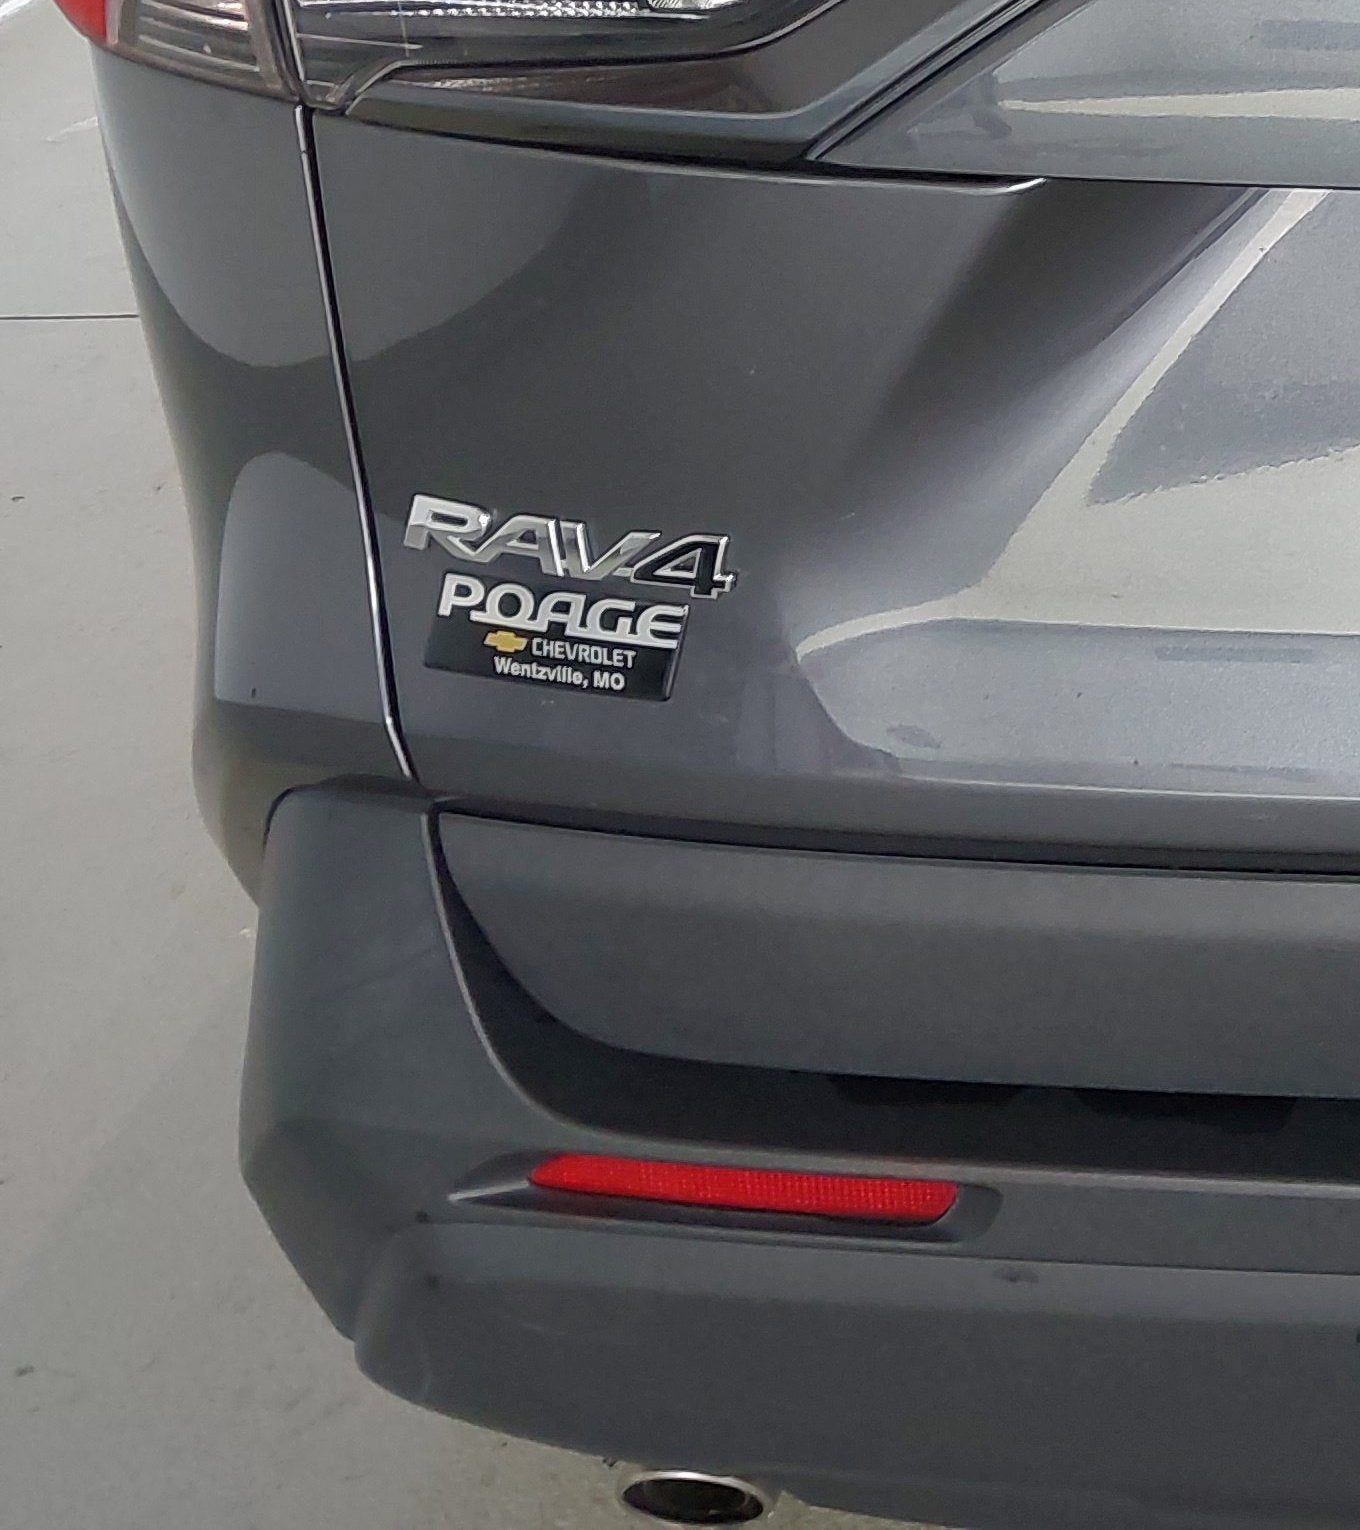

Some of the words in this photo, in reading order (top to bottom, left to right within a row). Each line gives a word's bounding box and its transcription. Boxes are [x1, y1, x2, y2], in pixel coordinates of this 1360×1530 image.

[403, 493, 738, 599] RAV4
[437, 571, 690, 650] POAGE
[493, 655, 589, 689] Wentzville,
[592, 670, 625, 691] MO
[531, 637, 637, 669] CHEVROLET
